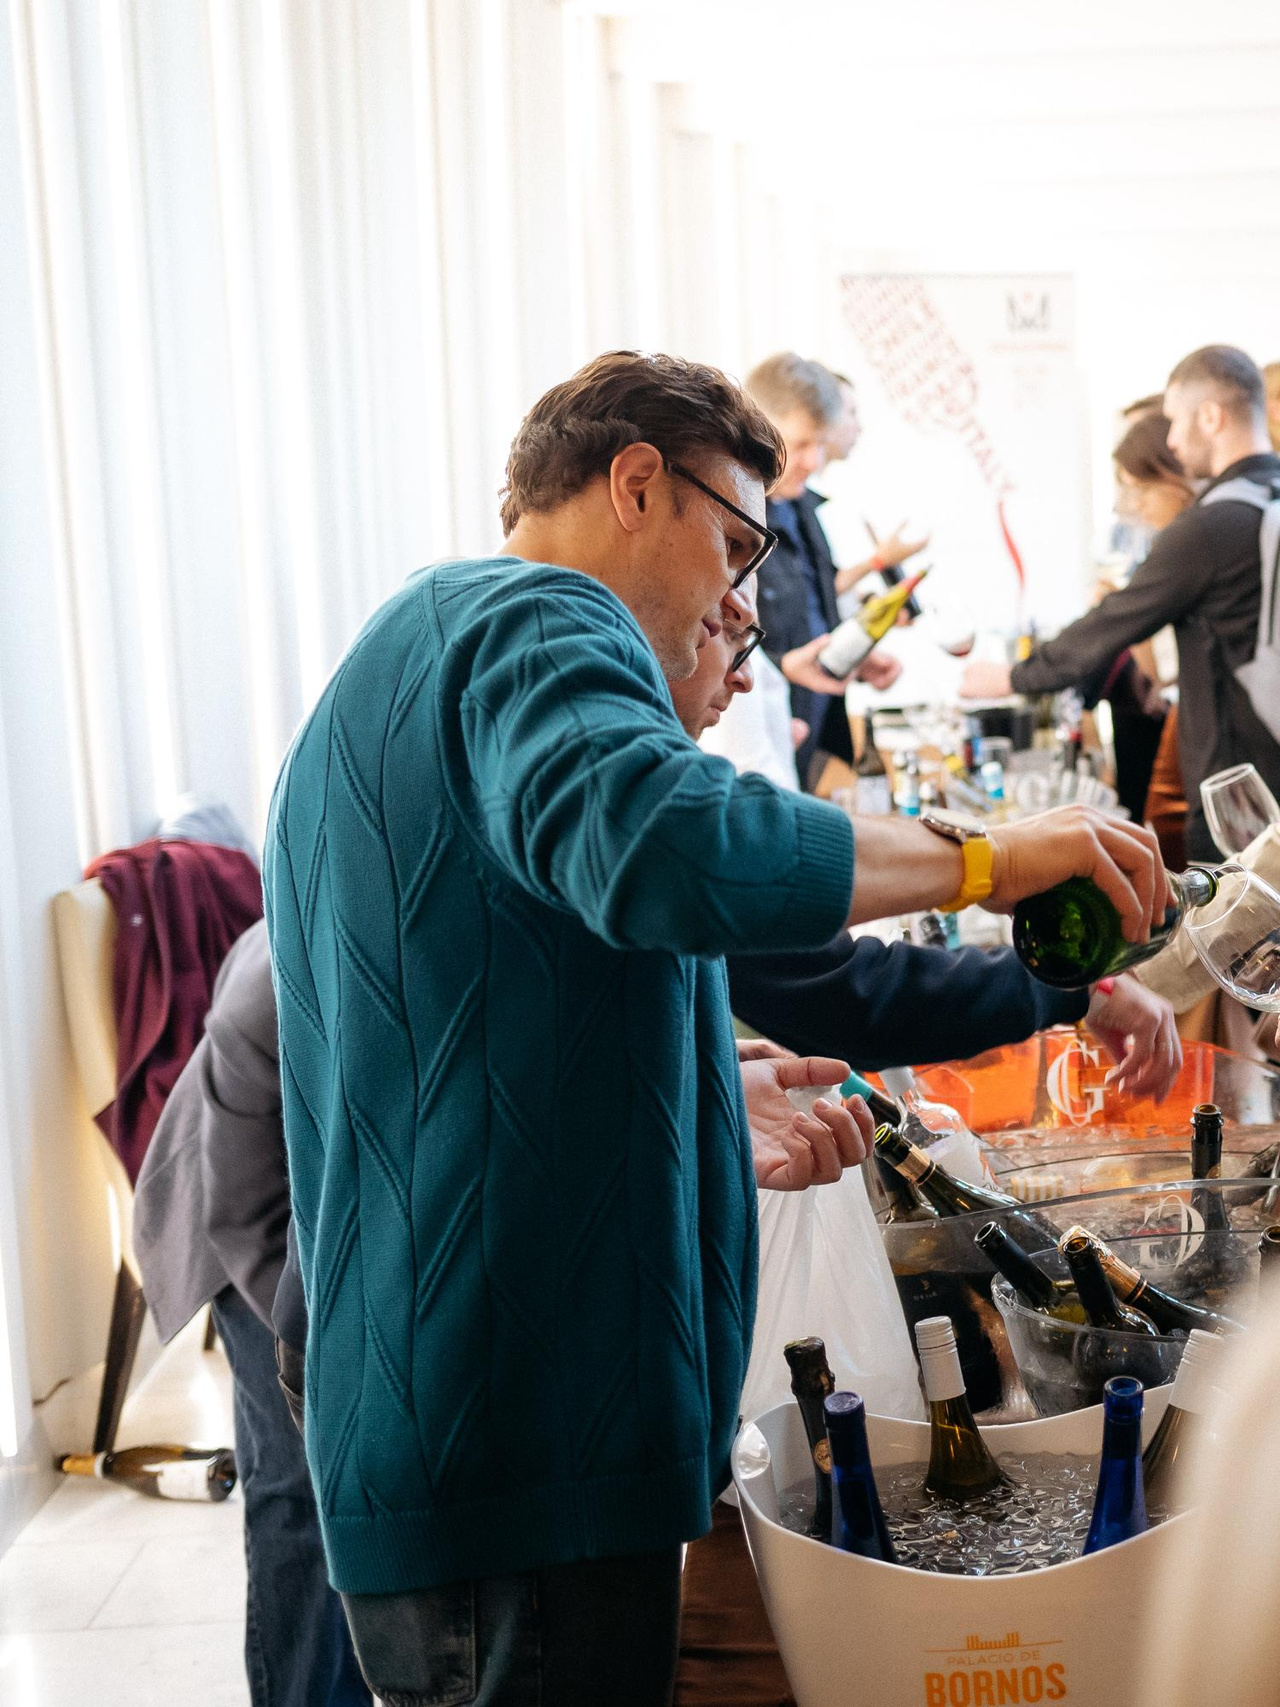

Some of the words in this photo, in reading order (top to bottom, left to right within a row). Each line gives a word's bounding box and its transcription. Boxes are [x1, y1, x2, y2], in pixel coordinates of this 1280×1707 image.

[947, 1653, 1014, 1666] PALACIO
[1020, 1650, 1041, 1661] DE
[925, 1662, 1067, 1707] BORNOS
